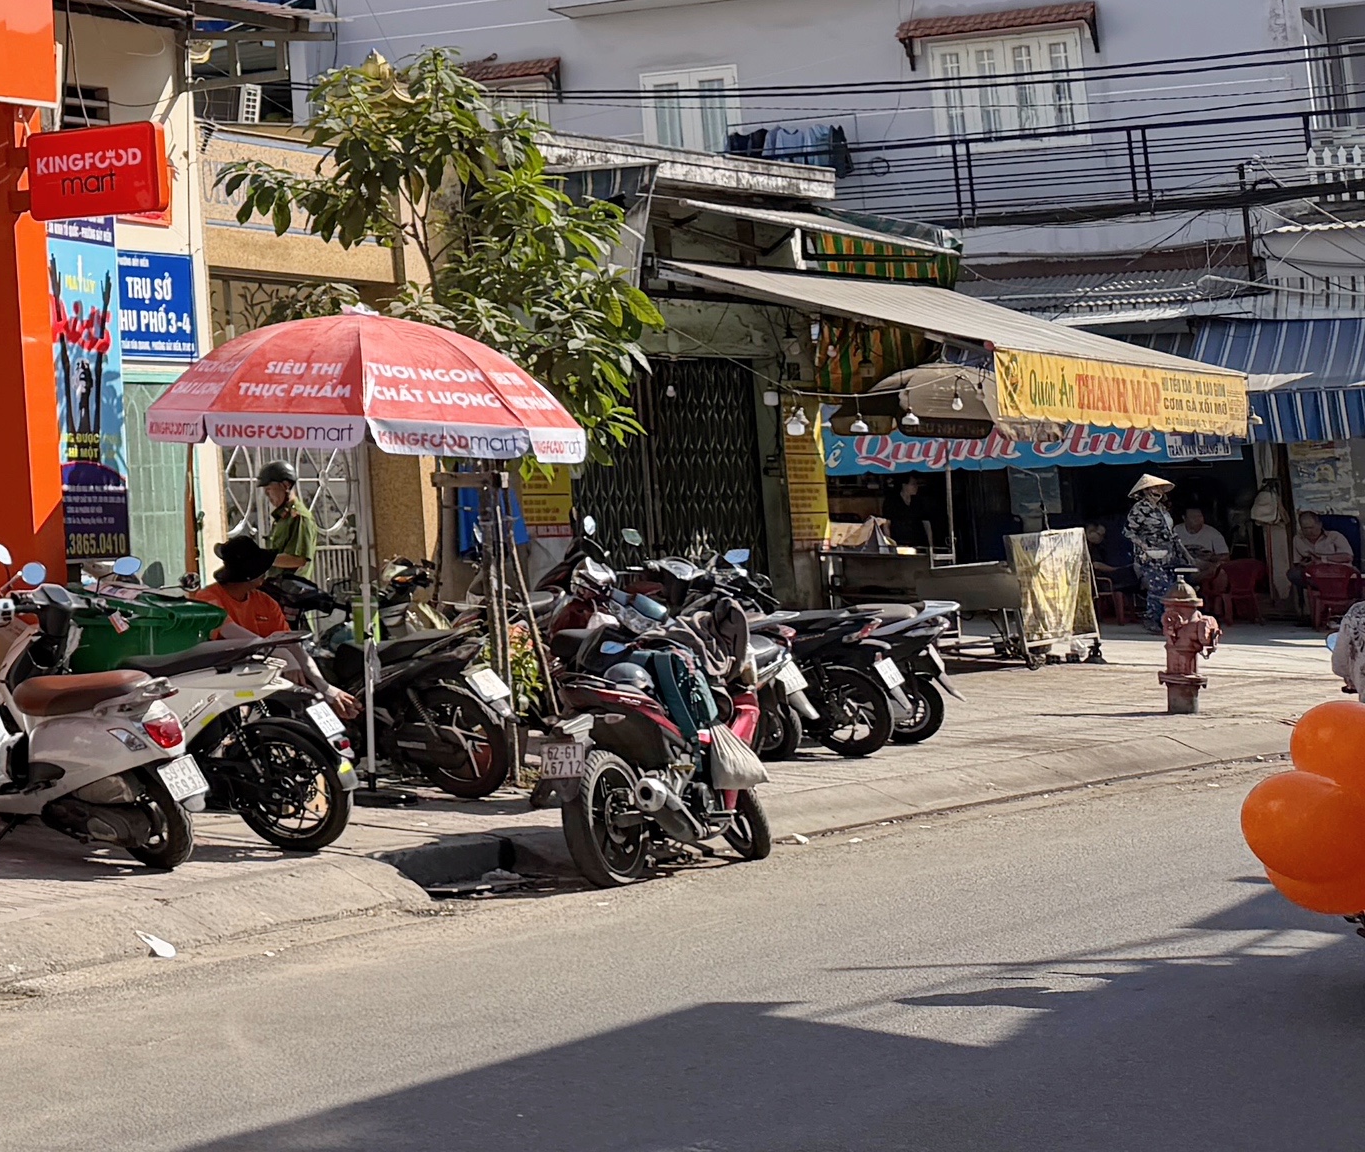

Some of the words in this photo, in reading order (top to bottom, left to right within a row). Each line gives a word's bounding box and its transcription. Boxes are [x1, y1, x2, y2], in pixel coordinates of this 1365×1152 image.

[35, 147, 143, 175] KINGFOOD
[61, 169, 117, 196] mart
[125, 276, 151, 304] TRỤ
[154, 272, 172, 300] SỞ
[119, 308, 138, 332] HU
[140, 301, 167, 334] PHỐ
[169, 313, 191, 334] 3-4
[264, 359, 308, 376] SIÊU
[311, 361, 345, 378] THỊ
[237, 381, 291, 400] THỰC
[294, 376, 352, 399] PHẨM
